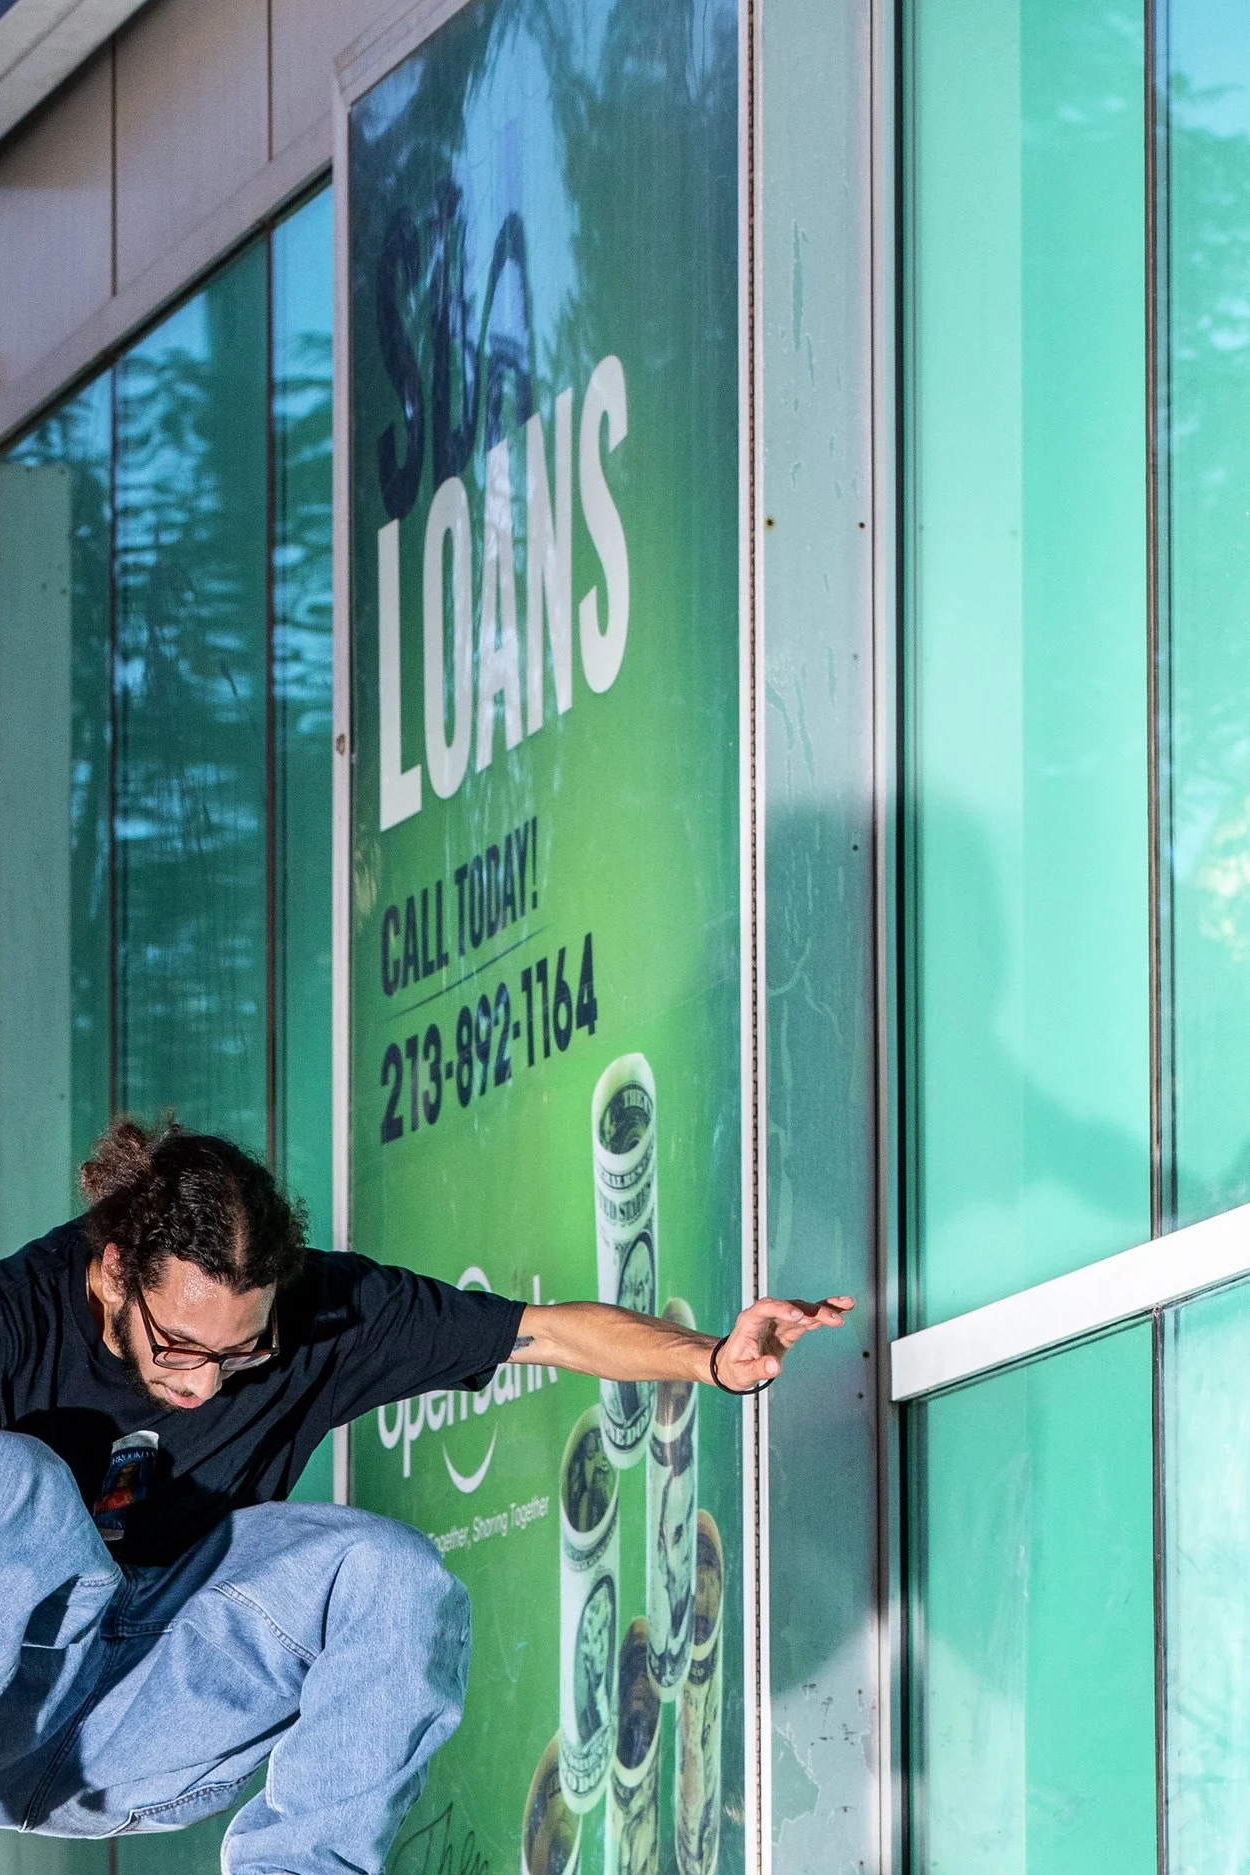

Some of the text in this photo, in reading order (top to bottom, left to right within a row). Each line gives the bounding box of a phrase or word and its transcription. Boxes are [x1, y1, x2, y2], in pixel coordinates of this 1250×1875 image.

[377, 355, 630, 833] LOANS
[381, 816, 538, 997] CALL TODAY!
[380, 931, 599, 1145] 213-892-1164
[472, 1515, 508, 1543] Sharing
[510, 1495, 550, 1531] Together
